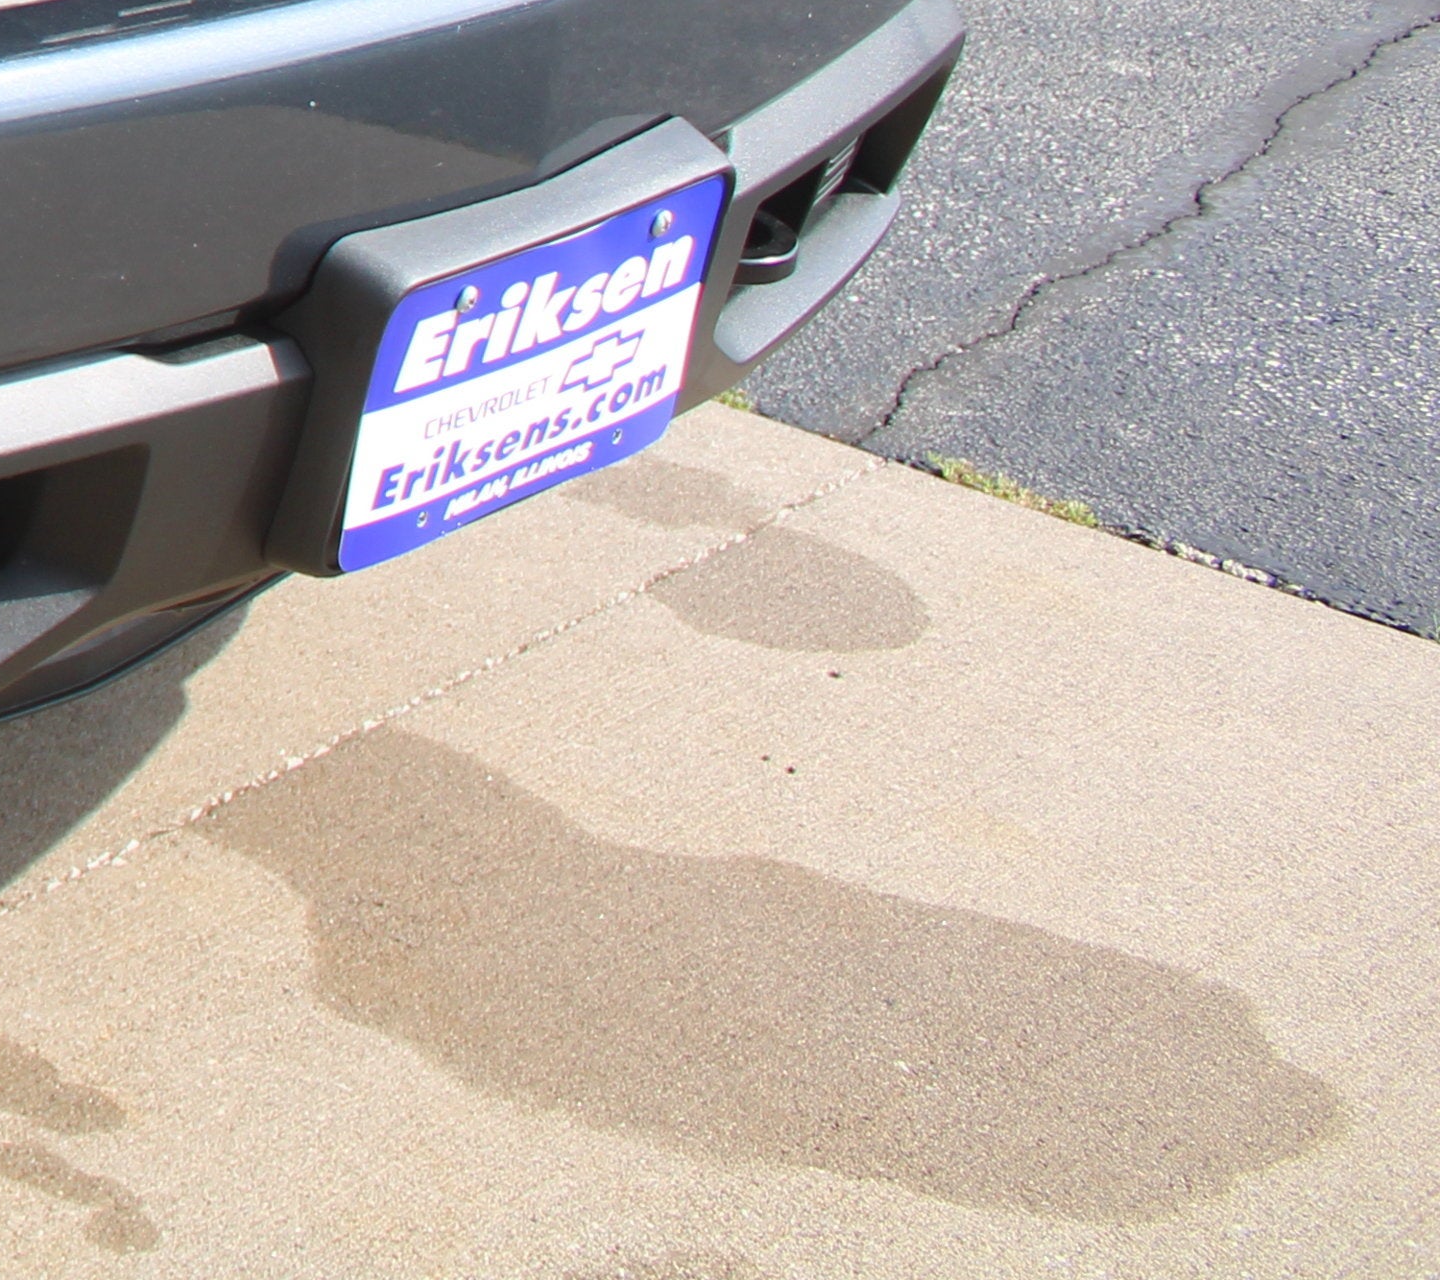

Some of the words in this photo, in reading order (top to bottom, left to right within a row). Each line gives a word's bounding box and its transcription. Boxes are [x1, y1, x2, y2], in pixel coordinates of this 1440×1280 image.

[393, 235, 694, 393] Eriksen
[371, 364, 667, 511] Eriksens.com
[424, 375, 553, 439] CHEVROLET
[509, 441, 595, 490] ILLINOIS
